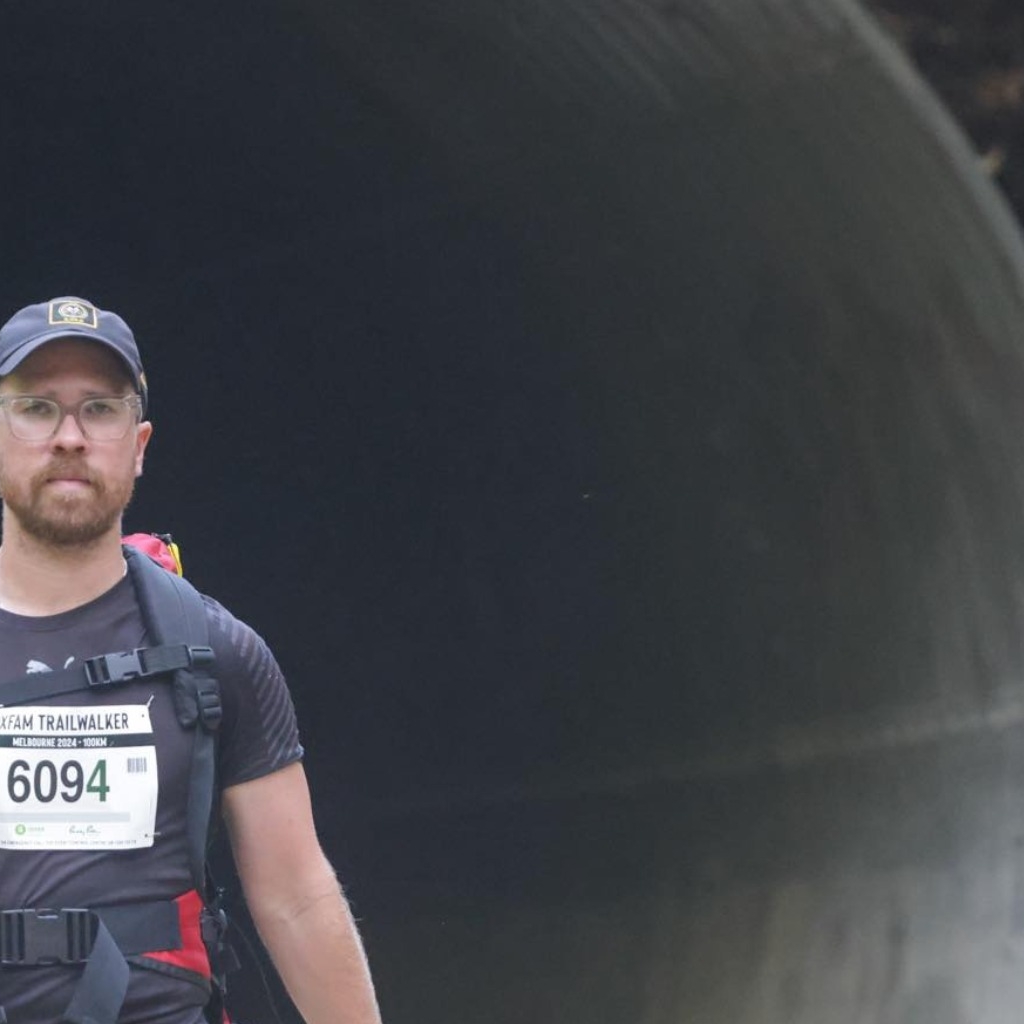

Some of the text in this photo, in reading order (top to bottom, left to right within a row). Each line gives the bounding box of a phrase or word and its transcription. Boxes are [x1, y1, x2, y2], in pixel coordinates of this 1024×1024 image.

[38, 712, 129, 731] TRAILWALKER
[12, 737, 56, 747] MELBOURNE
[57, 737, 77, 748] 2024
[83, 737, 107, 747] 100KM
[7, 759, 110, 803] 6094
